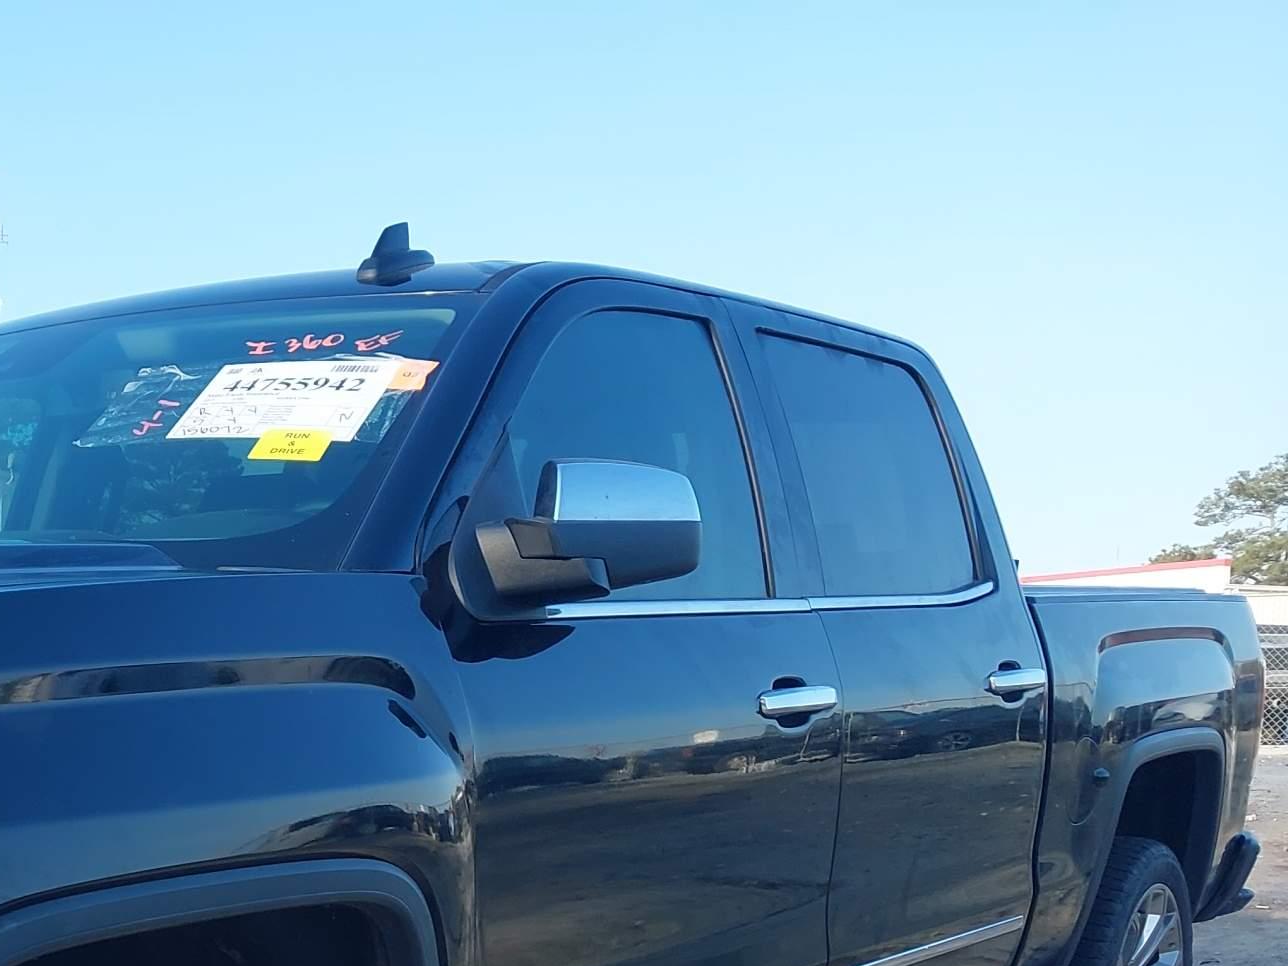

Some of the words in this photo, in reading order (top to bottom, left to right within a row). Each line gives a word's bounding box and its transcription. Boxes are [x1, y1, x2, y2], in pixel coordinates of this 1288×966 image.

[285, 333, 344, 352] 360
[223, 377, 366, 392] 44755942
[285, 432, 311, 440] RUN
[270, 447, 306, 455] DRIVE
